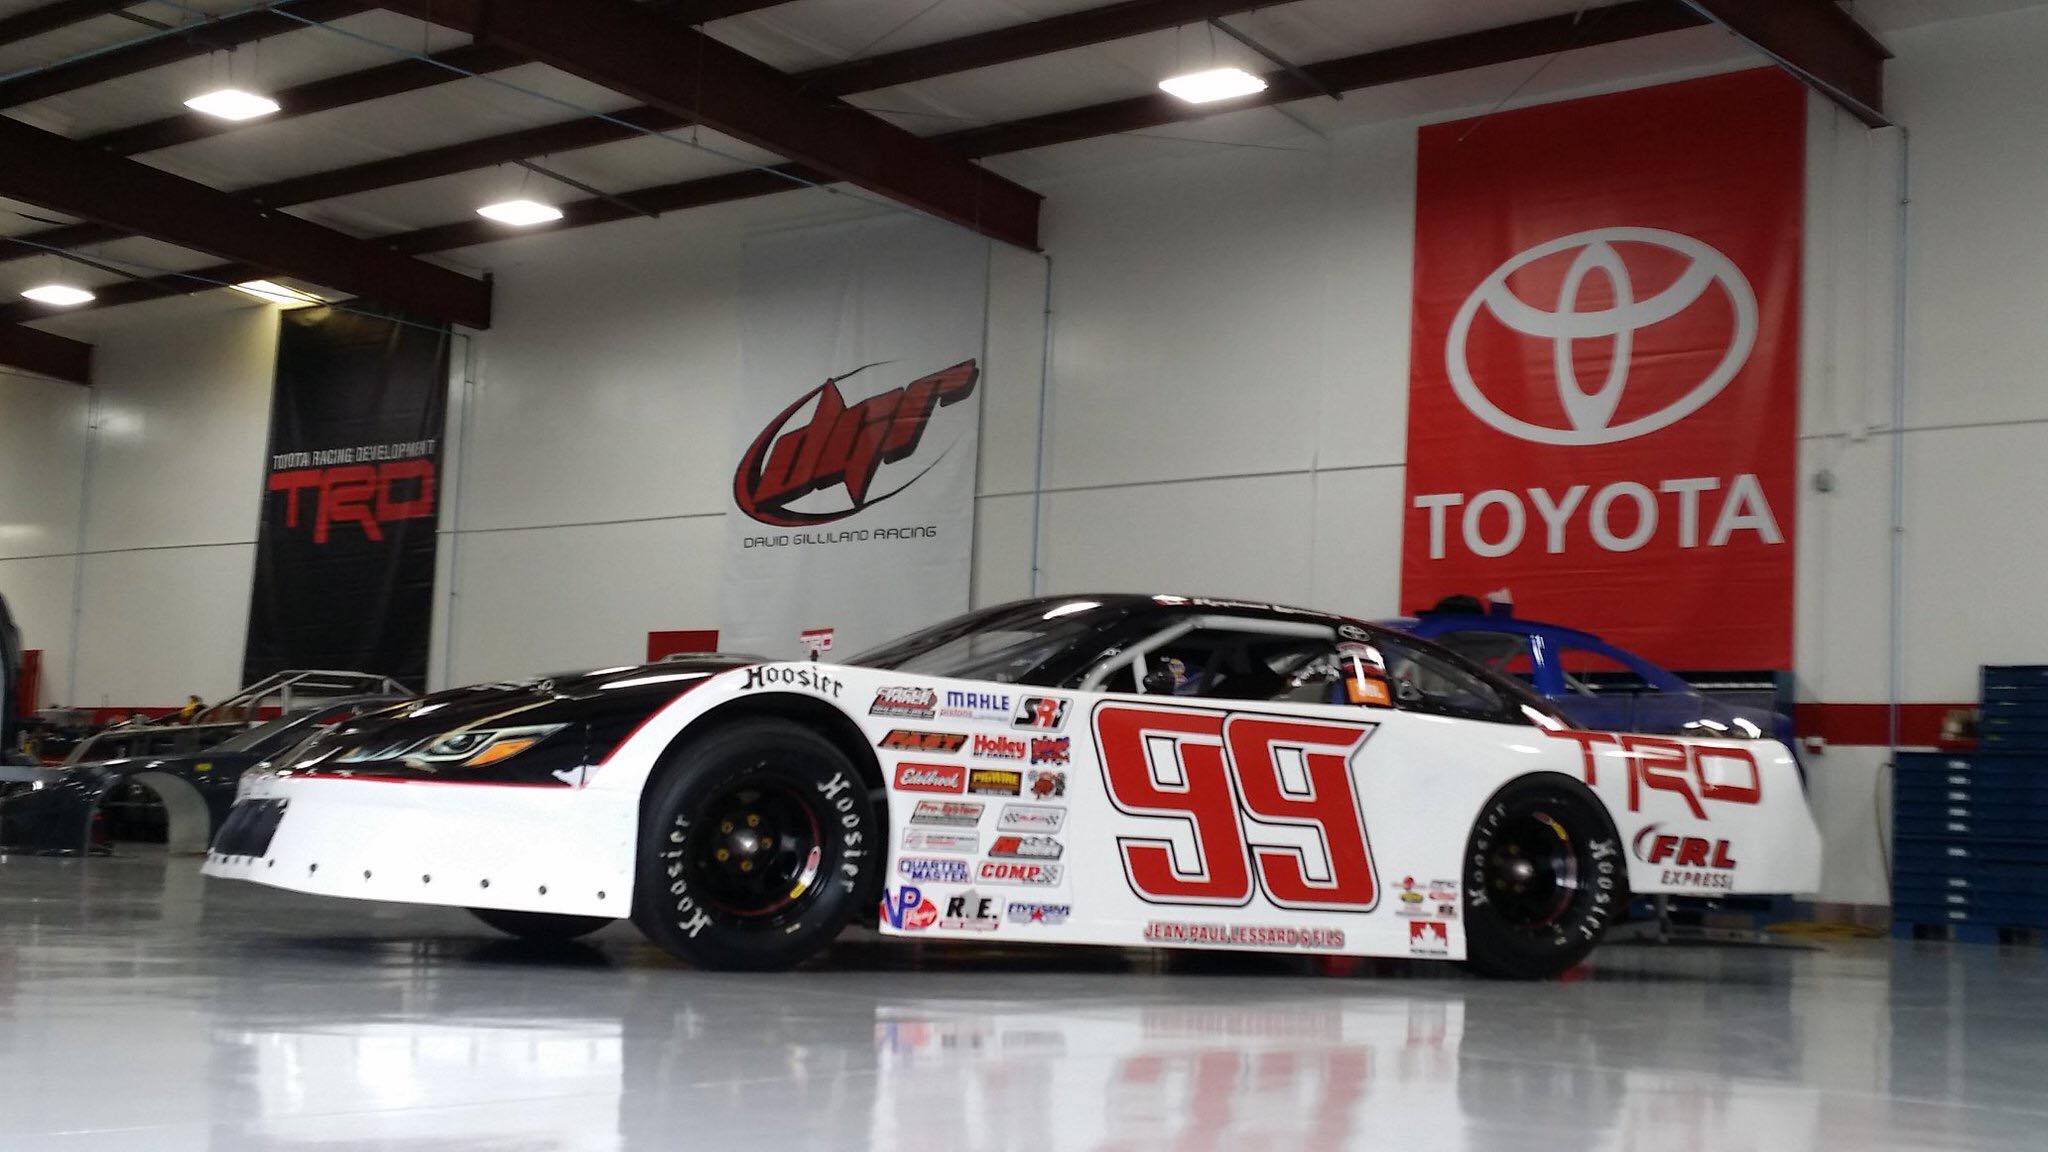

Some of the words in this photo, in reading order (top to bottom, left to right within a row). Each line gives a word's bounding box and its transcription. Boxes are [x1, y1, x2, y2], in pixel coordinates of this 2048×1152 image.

[272, 452, 311, 469] TOYOTA
[312, 447, 353, 465] RACING
[355, 440, 436, 462] DEVELOPMENT
[268, 458, 436, 544] TRD
[1413, 473, 1786, 560] TOYOTA
[743, 535, 789, 549] DAVID
[793, 529, 869, 546] GILLILAND
[873, 526, 937, 540] RACING
[739, 665, 844, 698] Hoosier
[947, 691, 1009, 710] MAHLE
[974, 734, 1026, 758] Holley
[1541, 729, 1761, 821] TRD
[1090, 699, 1381, 913] 99
[816, 771, 867, 893] Hoosier
[900, 859, 966, 874] QUARTER
[1647, 835, 1737, 869] FRL
[659, 814, 713, 938] Hoosier
[911, 869, 969, 882] MASTER
[981, 863, 1041, 881] COMP
[1660, 870, 1733, 889] EXPRESS
[884, 885, 922, 929] VP
[1144, 922, 1185, 940] JEAN
[1188, 924, 1229, 943] PAUL
[1230, 925, 1297, 946] LESSARD
